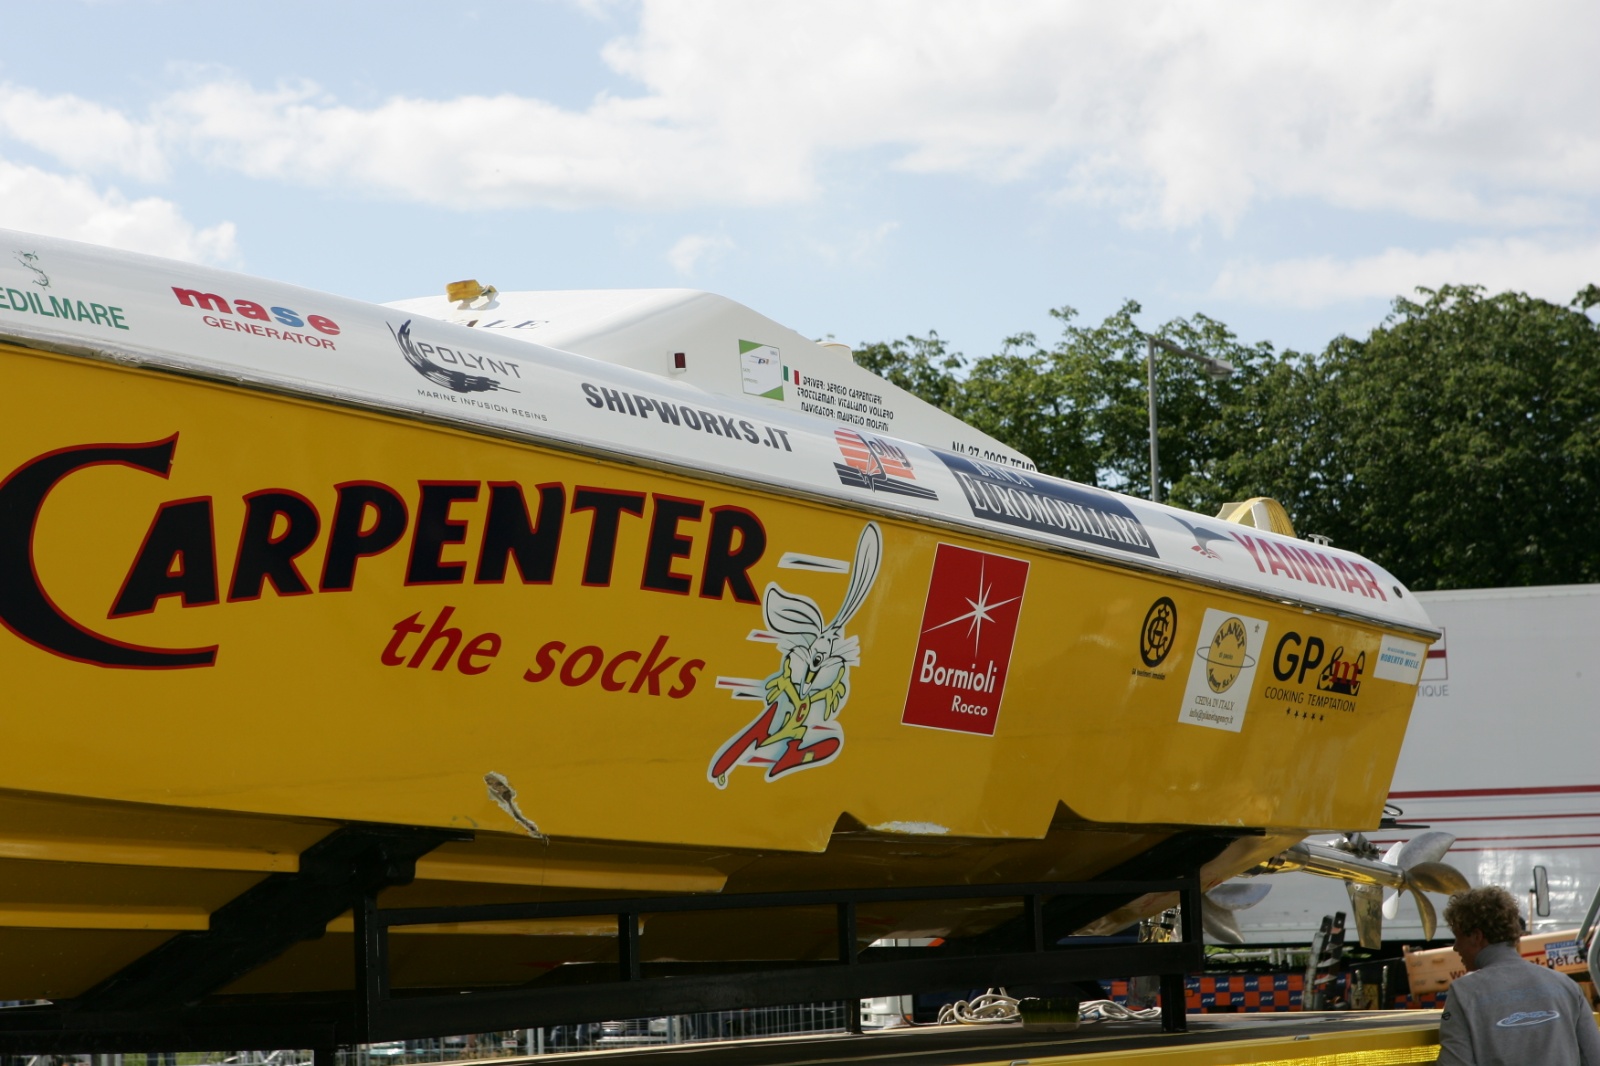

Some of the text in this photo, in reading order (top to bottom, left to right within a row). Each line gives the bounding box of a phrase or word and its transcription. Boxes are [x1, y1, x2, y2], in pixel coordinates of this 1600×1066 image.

[171, 286, 341, 336] mase
[202, 315, 337, 351] GENERATOR
[416, 341, 521, 379] POLYNT
[417, 389, 548, 422] MARINE INFUSION RESINS
[827, 383, 847, 396] SERGIO
[581, 382, 793, 452] SHIPWORKS.IT
[869, 405, 894, 420] VOLLERO
[968, 459, 1034, 488] BANCA
[955, 470, 1150, 548] EUROMOBILIARE
[0, 432, 767, 670] CARPENTER
[1228, 531, 1388, 602] YANMAR
[381, 605, 706, 699] the socks
[1214, 622, 1245, 648] PLANET
[919, 649, 998, 694] Bormioli
[1273, 631, 1325, 684] GP
[951, 695, 988, 716] Rocco
[1264, 686, 1356, 712] COOKING TEMPTATION
